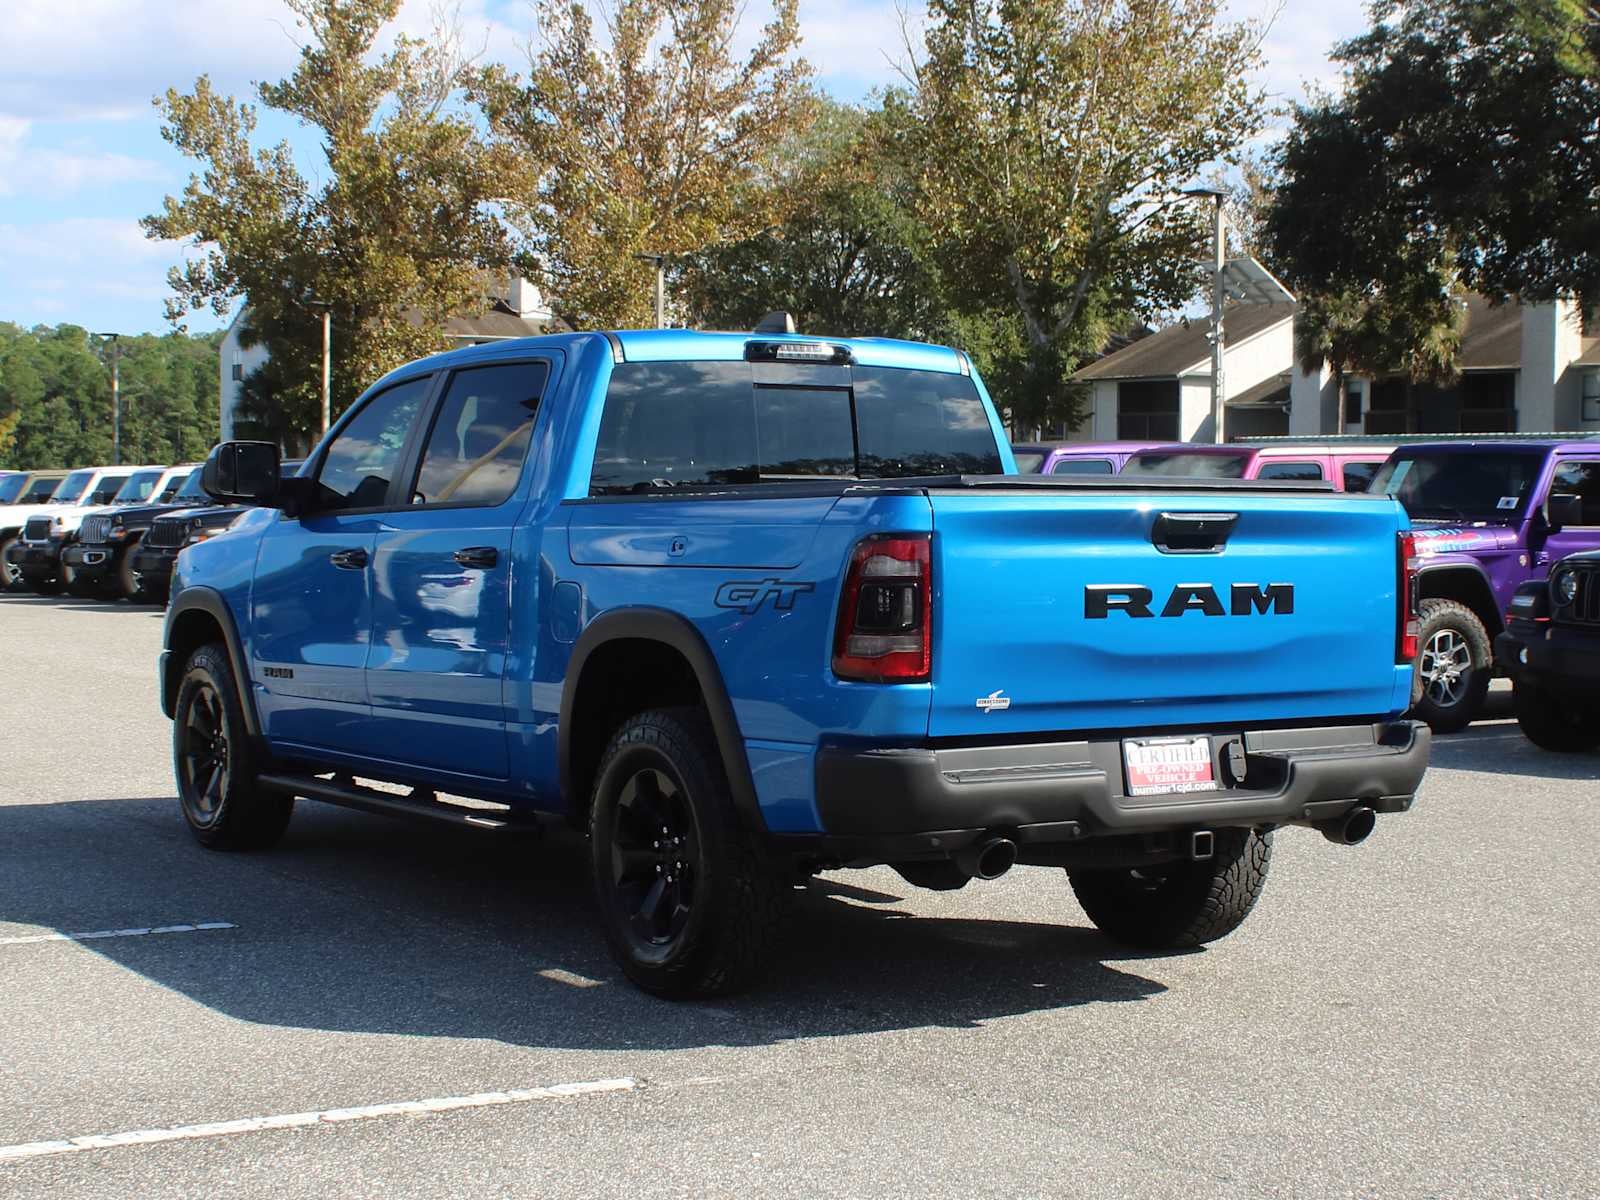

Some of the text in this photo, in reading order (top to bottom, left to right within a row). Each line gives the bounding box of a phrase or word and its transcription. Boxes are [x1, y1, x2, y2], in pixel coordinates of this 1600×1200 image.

[1084, 583, 1294, 619] RAM
[263, 667, 294, 679] RAM
[1128, 747, 1209, 764] CERTIFIED
[1136, 763, 1205, 774] PRE-OWNED
[1145, 772, 1197, 783] VEHICLE
[1133, 782, 1216, 794] number1cjd.com
